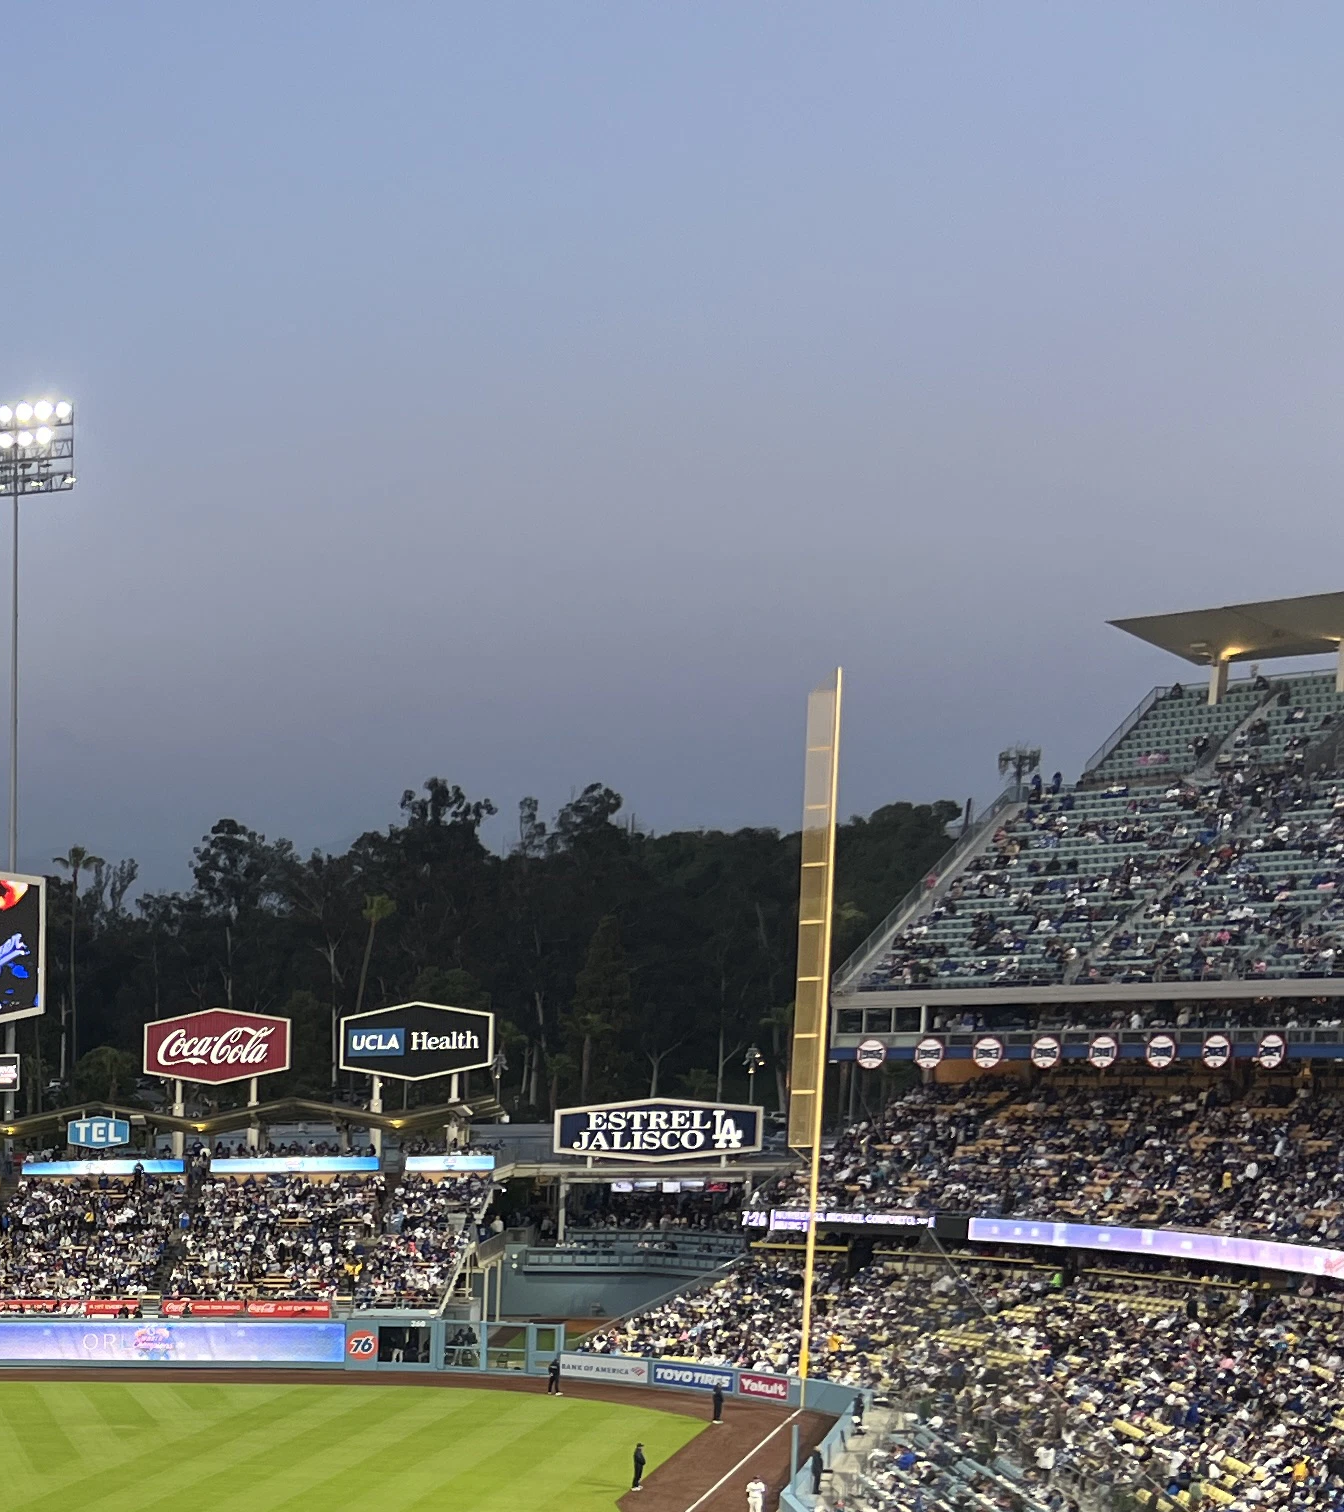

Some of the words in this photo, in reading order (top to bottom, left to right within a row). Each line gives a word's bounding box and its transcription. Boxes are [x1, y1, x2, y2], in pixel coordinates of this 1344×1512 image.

[157, 1026, 275, 1066] Coca-Cola
[352, 1033, 399, 1051] UCLA
[411, 1030, 480, 1052] Health
[74, 1121, 123, 1144] TEL
[573, 1130, 704, 1151] JALISCO
[350, 1335, 375, 1354] 76
[561, 1363, 583, 1371] BANK
[596, 1366, 629, 1375] AMERICA
[655, 1367, 694, 1384] TOYO
[741, 1378, 786, 1397] Yakult
